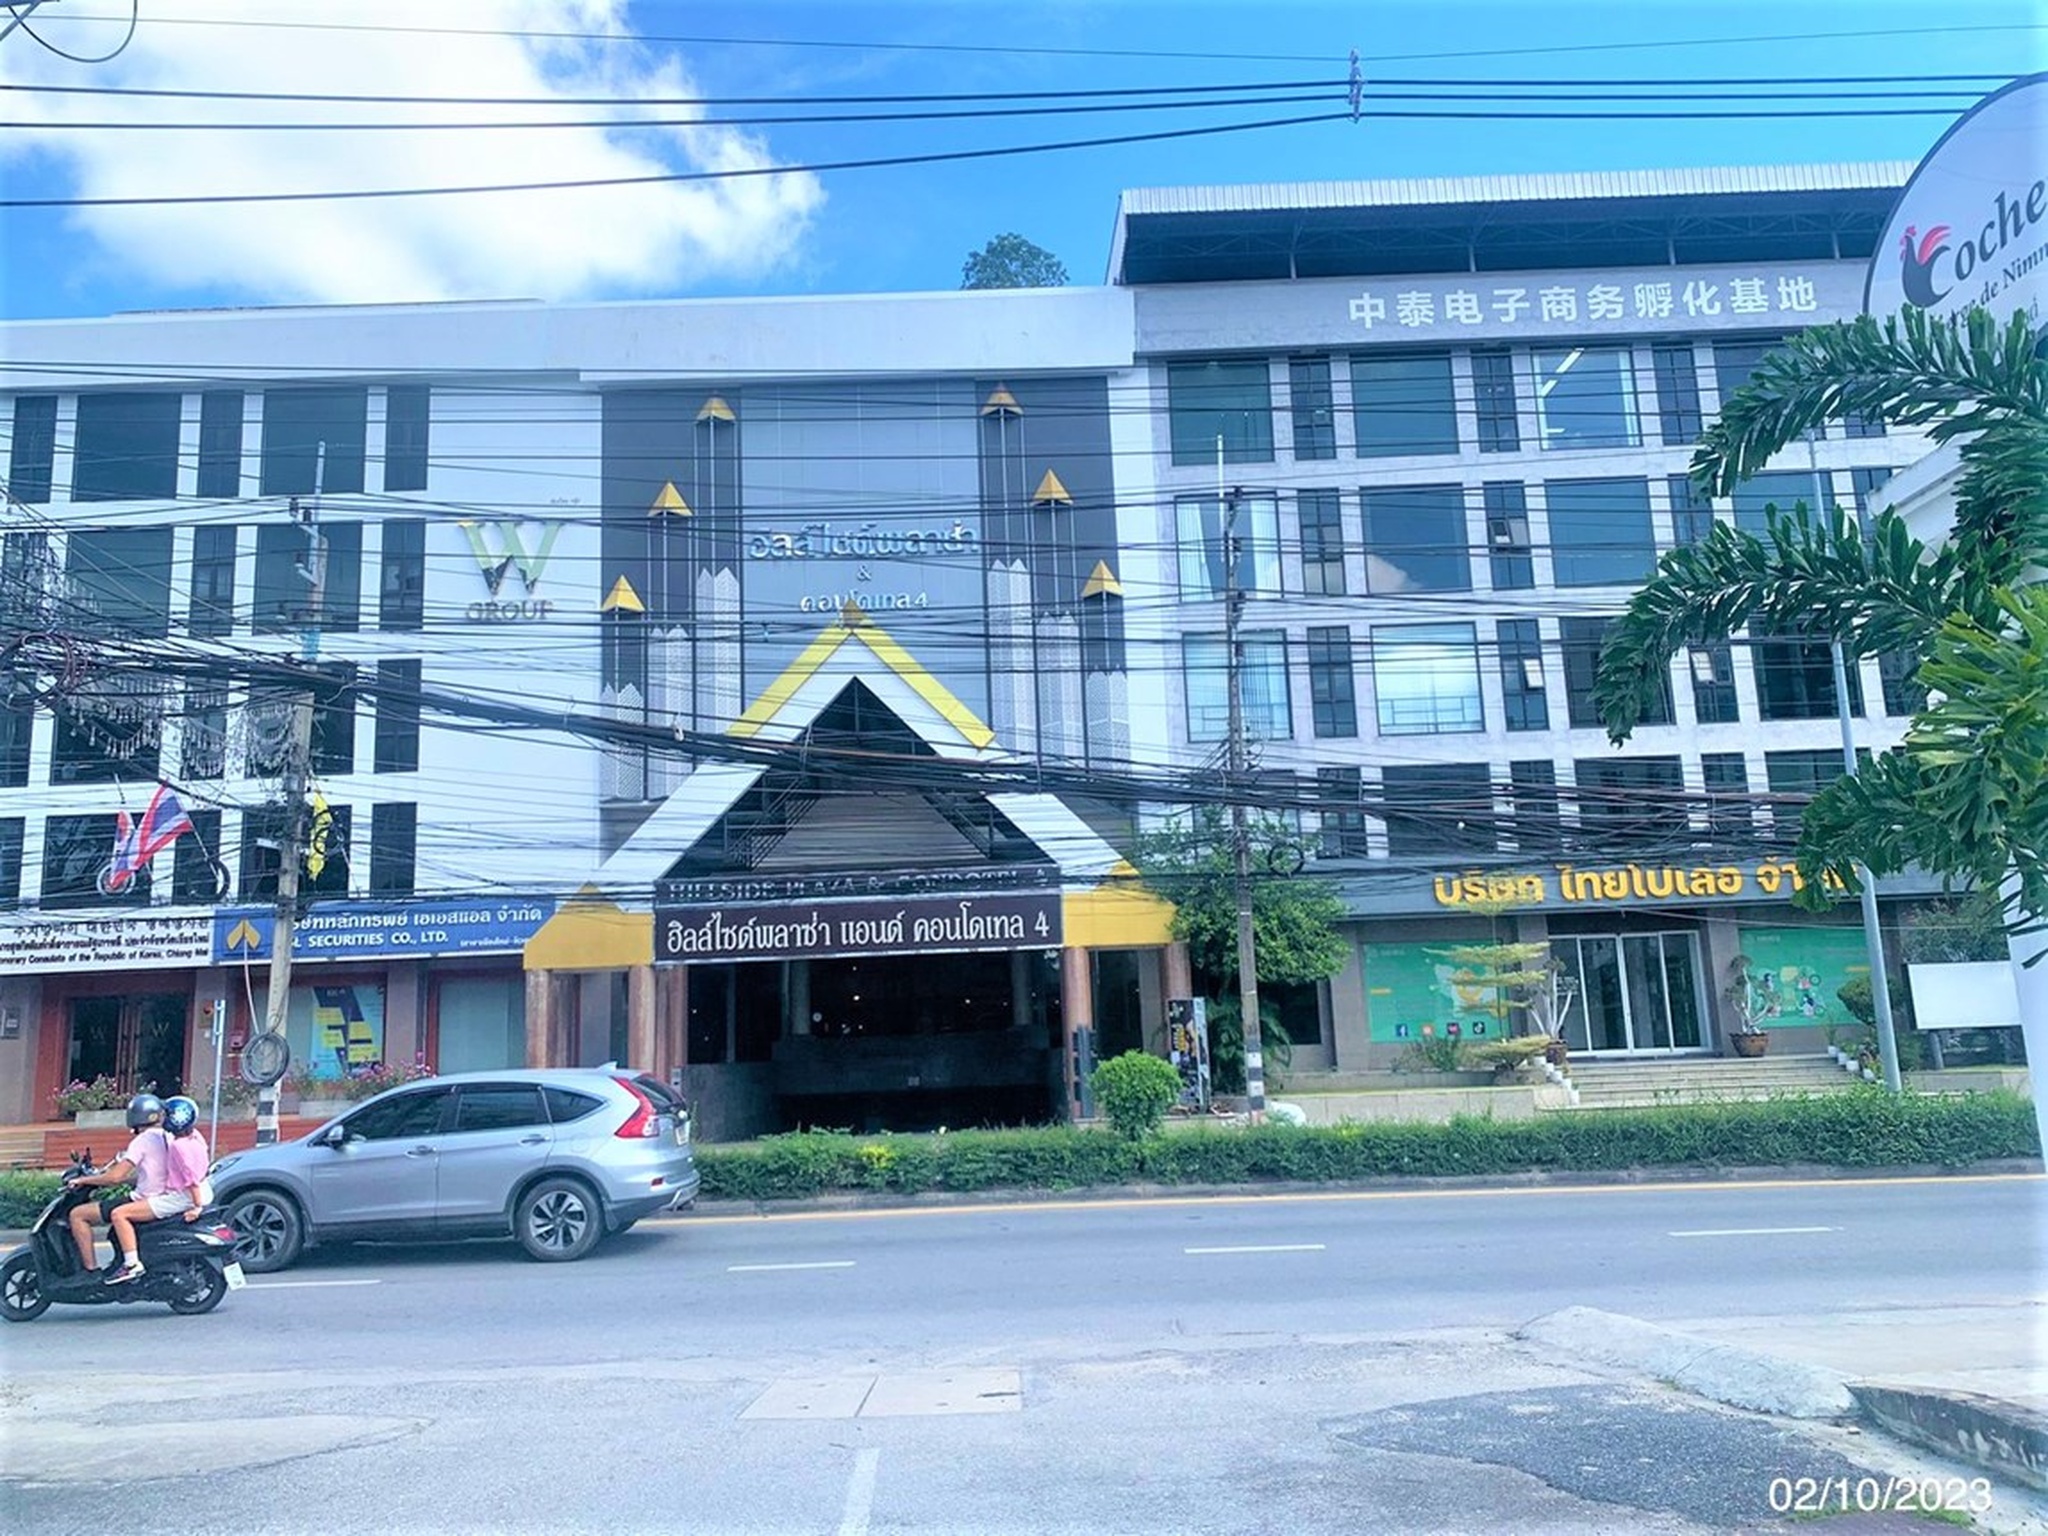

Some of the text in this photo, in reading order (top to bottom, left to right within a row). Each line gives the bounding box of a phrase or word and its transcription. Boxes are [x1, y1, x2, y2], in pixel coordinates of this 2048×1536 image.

[1348, 277, 1818, 329] 中泰电子商务孵化基地
[1980, 281, 1999, 306] de
[856, 565, 872, 582] &
[465, 600, 553, 620] GROUP
[497, 904, 542, 922] จำกัด
[667, 902, 1050, 953] ฮิลล์ไซด์พลาซ่า แอนด์ คอนโดเทล 4
[308, 934, 384, 948] SECURITIES
[391, 932, 418, 946] CO.,
[421, 931, 449, 943] LTD.
[68, 953, 77, 962] of
[78, 952, 92, 962] the
[128, 950, 137, 960] of
